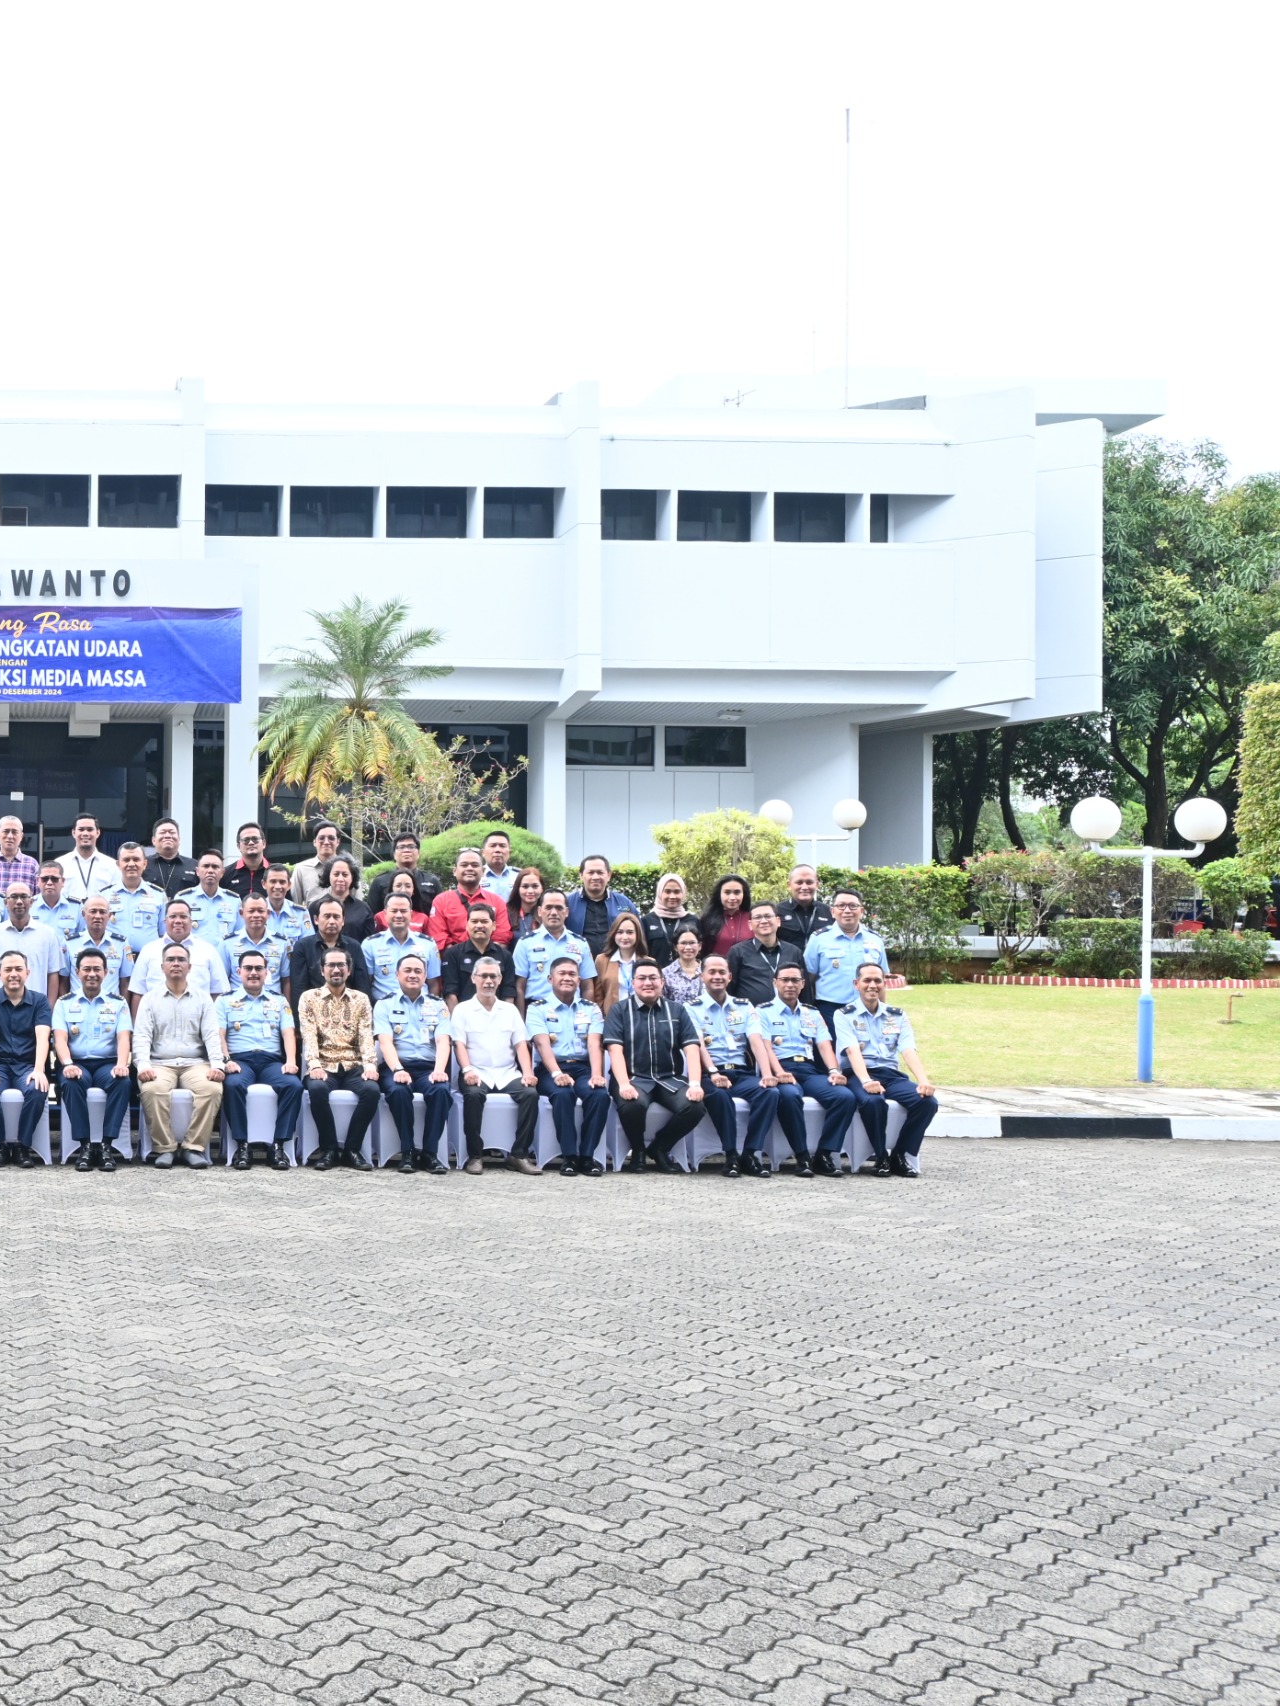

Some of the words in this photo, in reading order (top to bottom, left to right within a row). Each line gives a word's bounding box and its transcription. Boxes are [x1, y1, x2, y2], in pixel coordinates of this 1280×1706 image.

[33, 611, 94, 633] Rasa
[84, 640, 143, 657] UDARA
[30, 669, 84, 687] MEDIA
[86, 669, 147, 688] MASSA
[2, 688, 43, 696] DESEMBER
[43, 688, 62, 696] 2024
